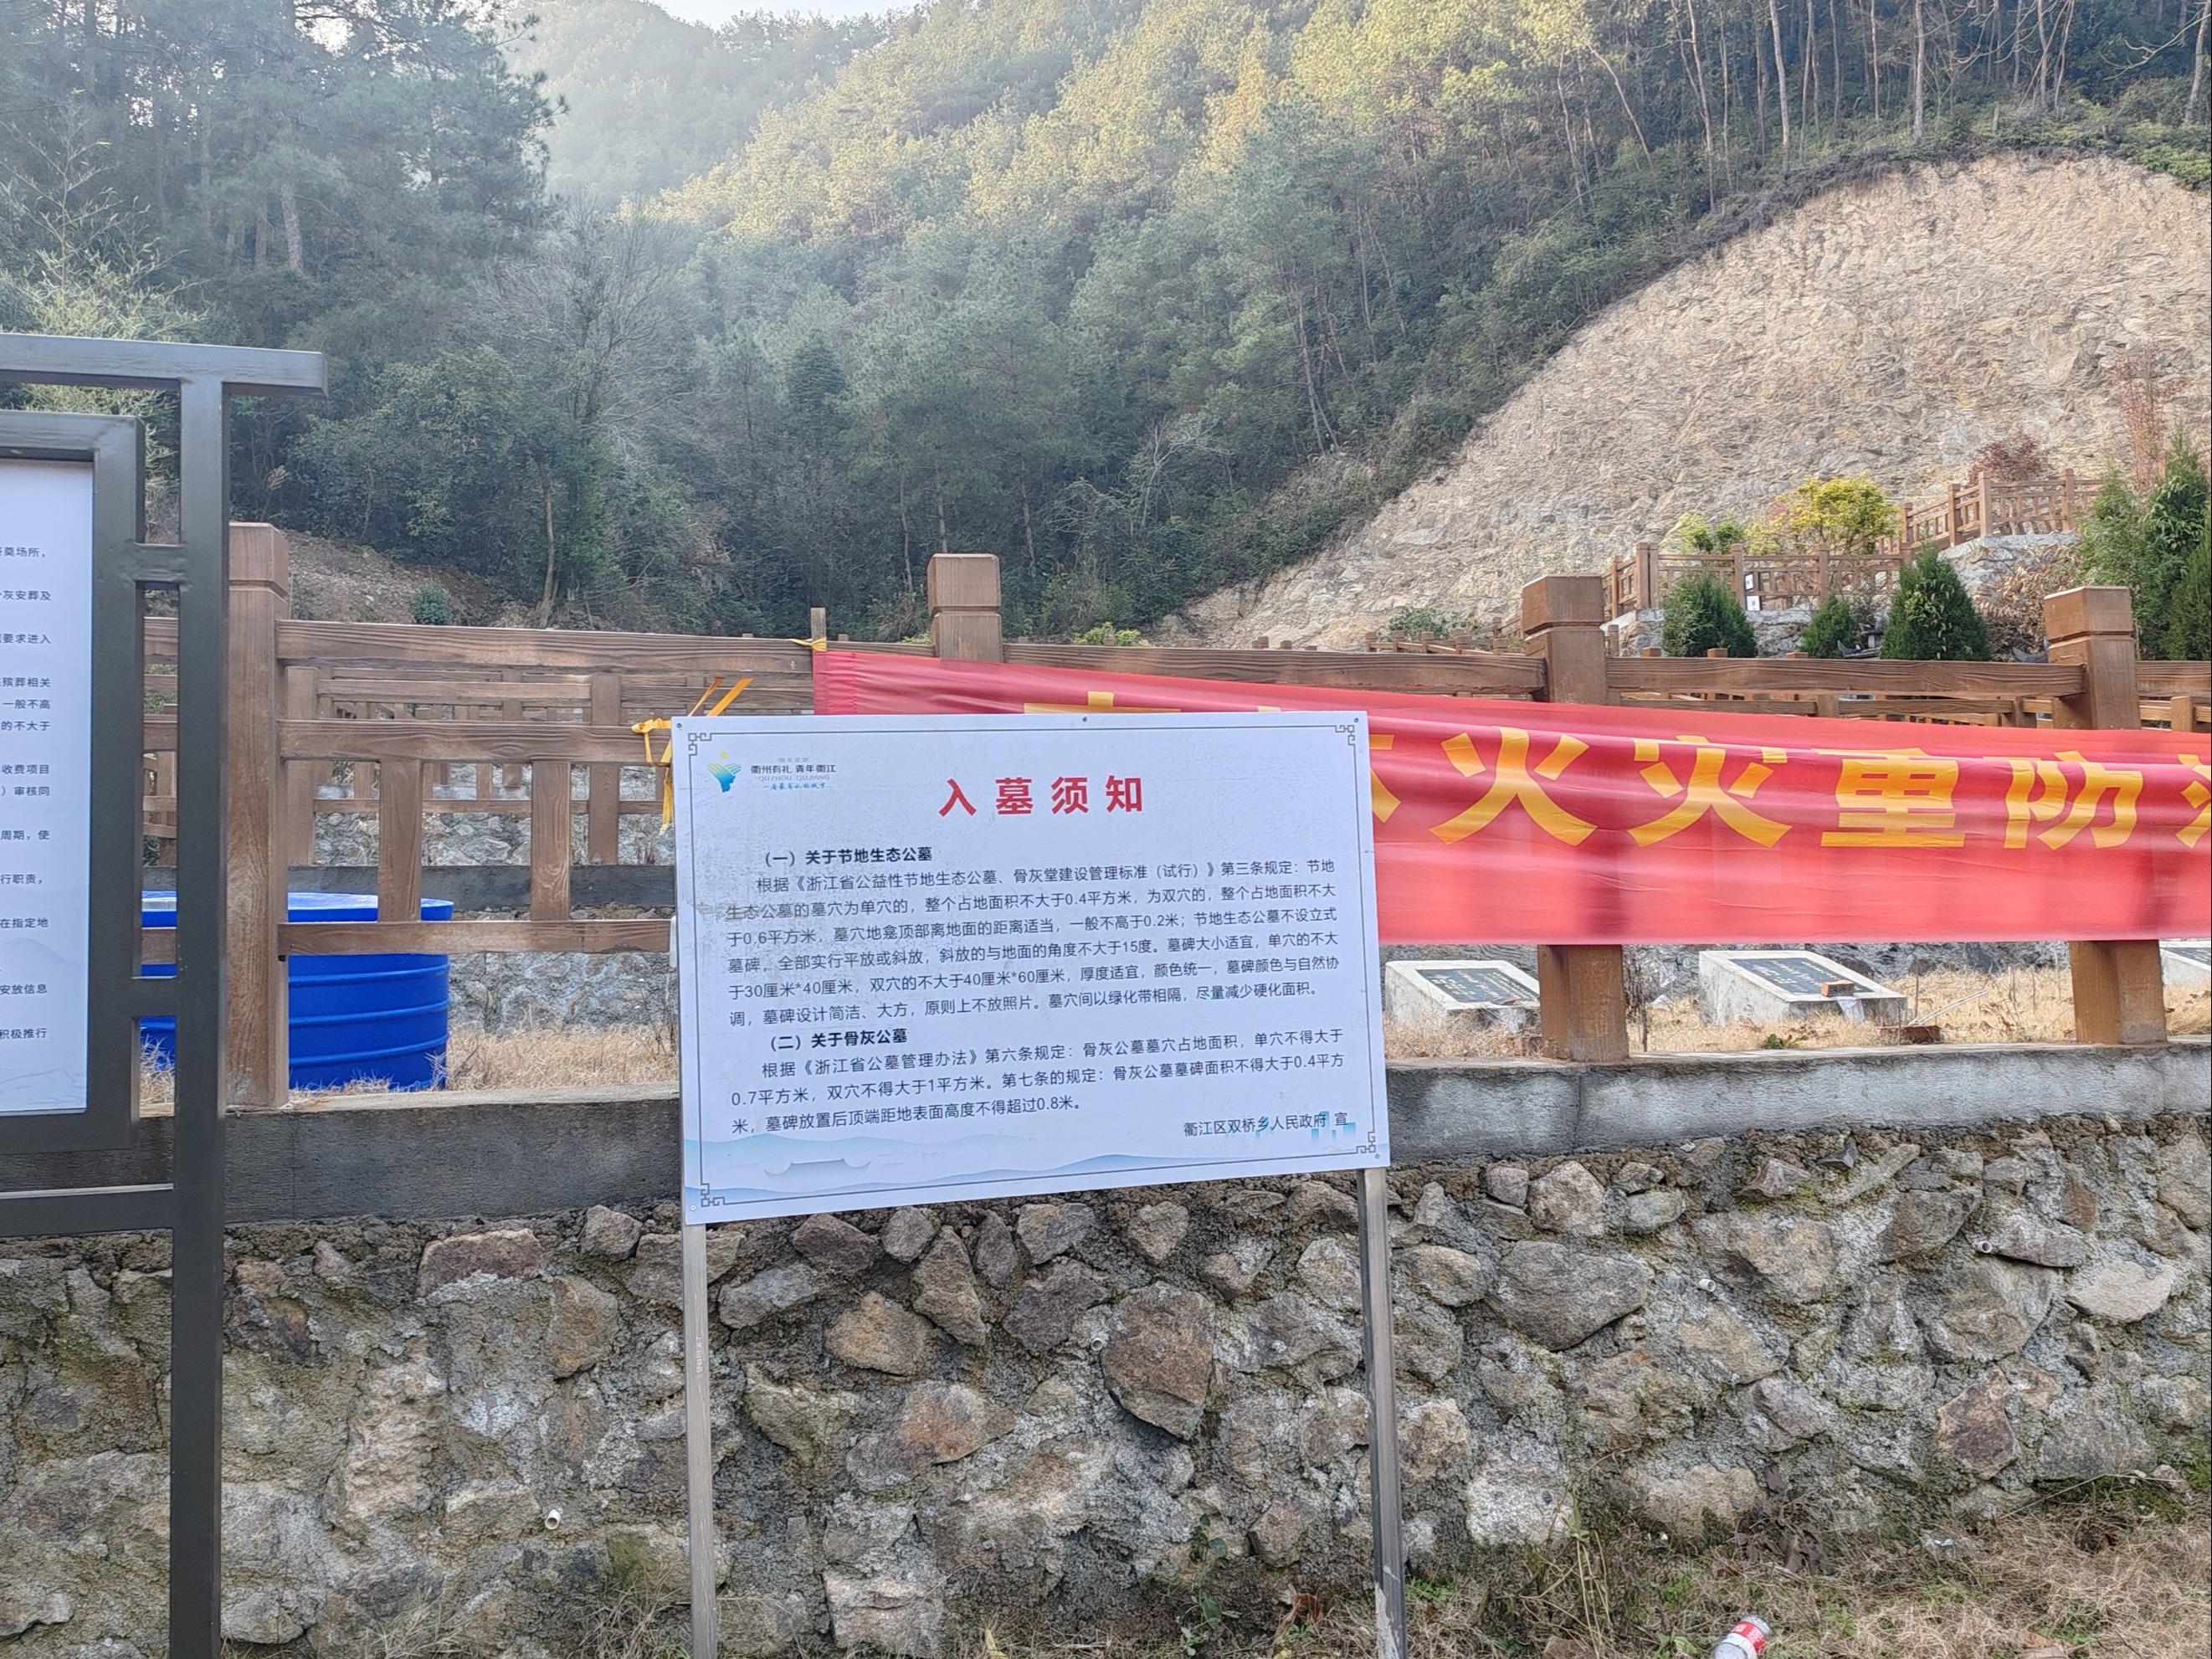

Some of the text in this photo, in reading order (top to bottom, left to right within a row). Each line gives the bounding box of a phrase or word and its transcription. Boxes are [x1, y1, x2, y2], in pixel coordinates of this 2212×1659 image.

[0, 547, 45, 558] 奠场所，
[0, 590, 51, 601] 灰安葬及
[0, 634, 51, 644] 要求进入
[0, 677, 51, 687] 殡葬相关
[1, 721, 50, 731] 的不大于
[2, 764, 49, 774] 收费项目
[938, 775, 1143, 817] 入墓须知
[0, 984, 48, 994] 安放信息
[1334, 1112, 1348, 1127] 宣
